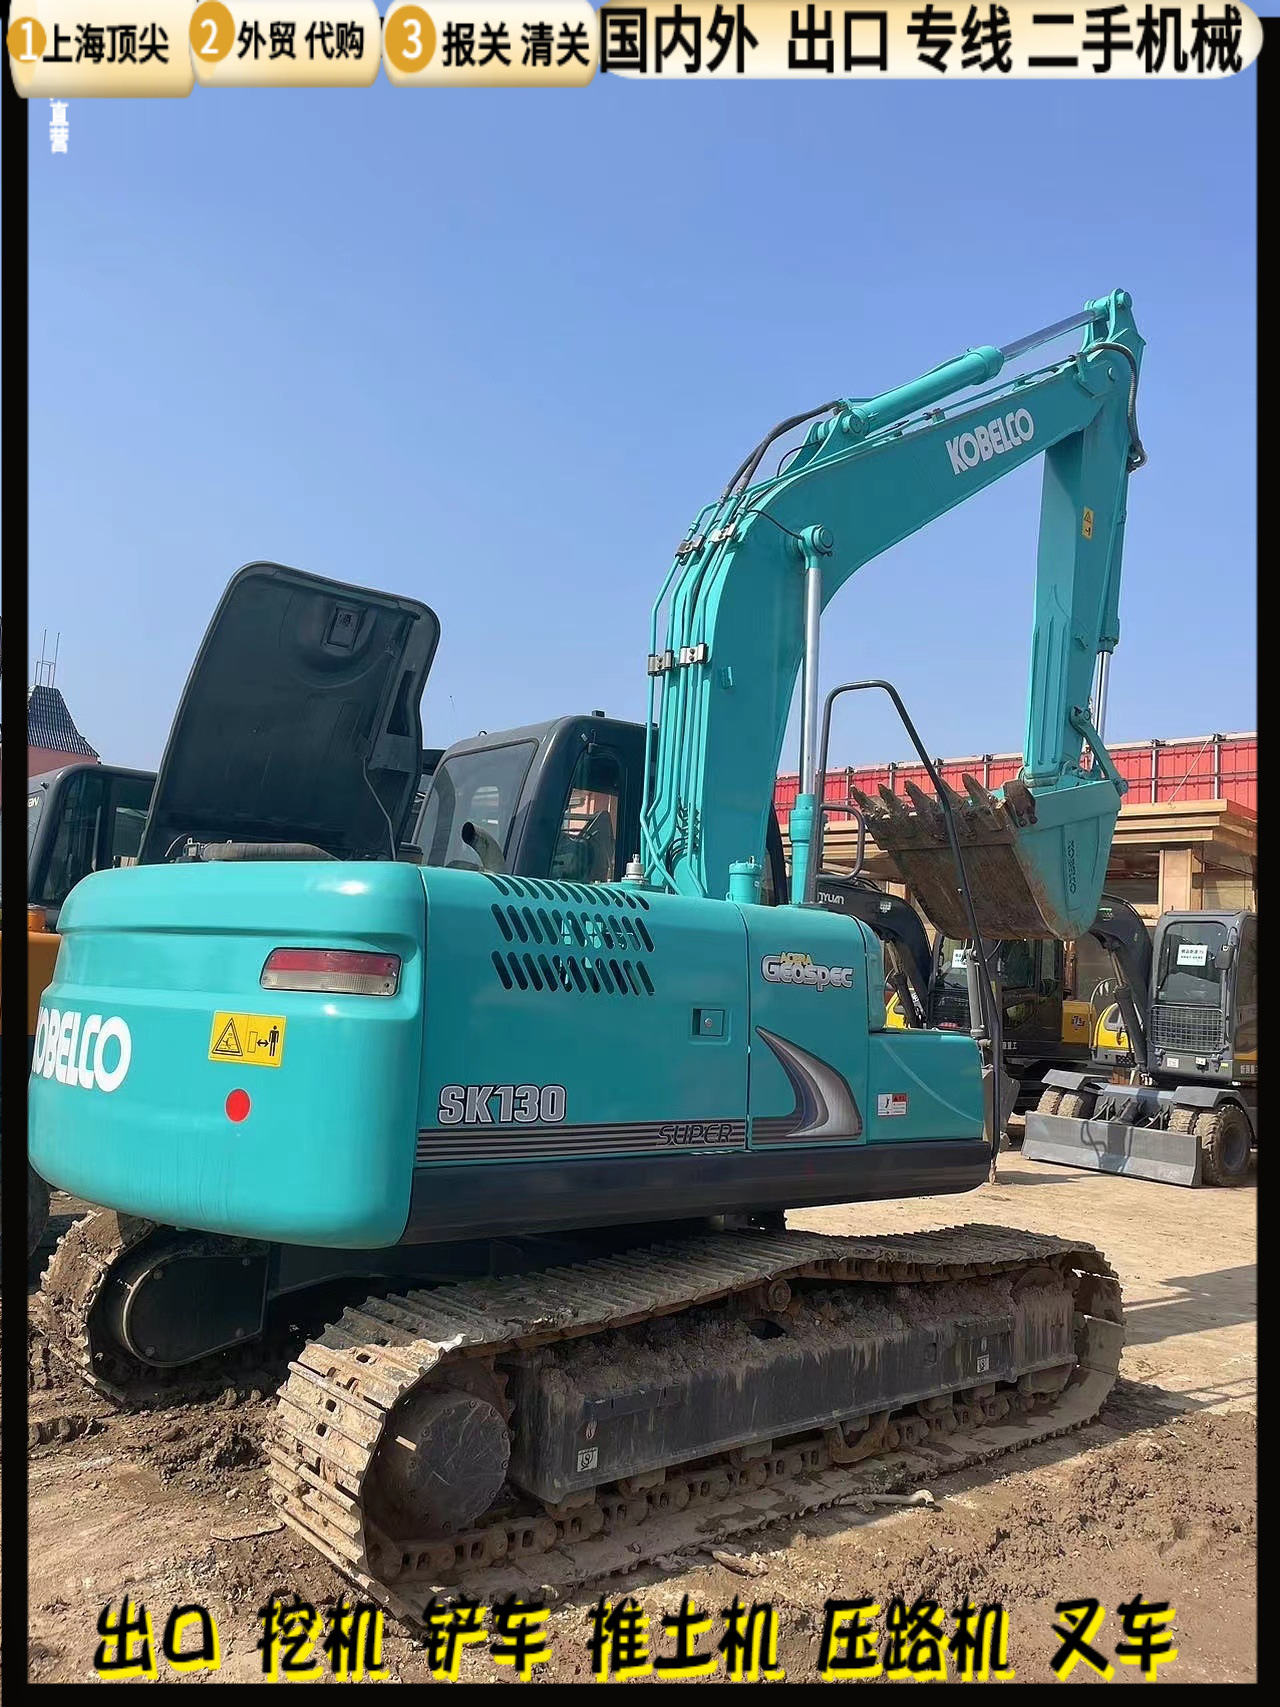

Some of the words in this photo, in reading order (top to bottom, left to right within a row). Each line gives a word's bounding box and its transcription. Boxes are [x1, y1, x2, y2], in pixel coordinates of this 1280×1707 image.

[945, 408, 1034, 475] KOBELCO
[438, 1084, 567, 1124] SK130
[656, 1123, 733, 1146] SUPER
